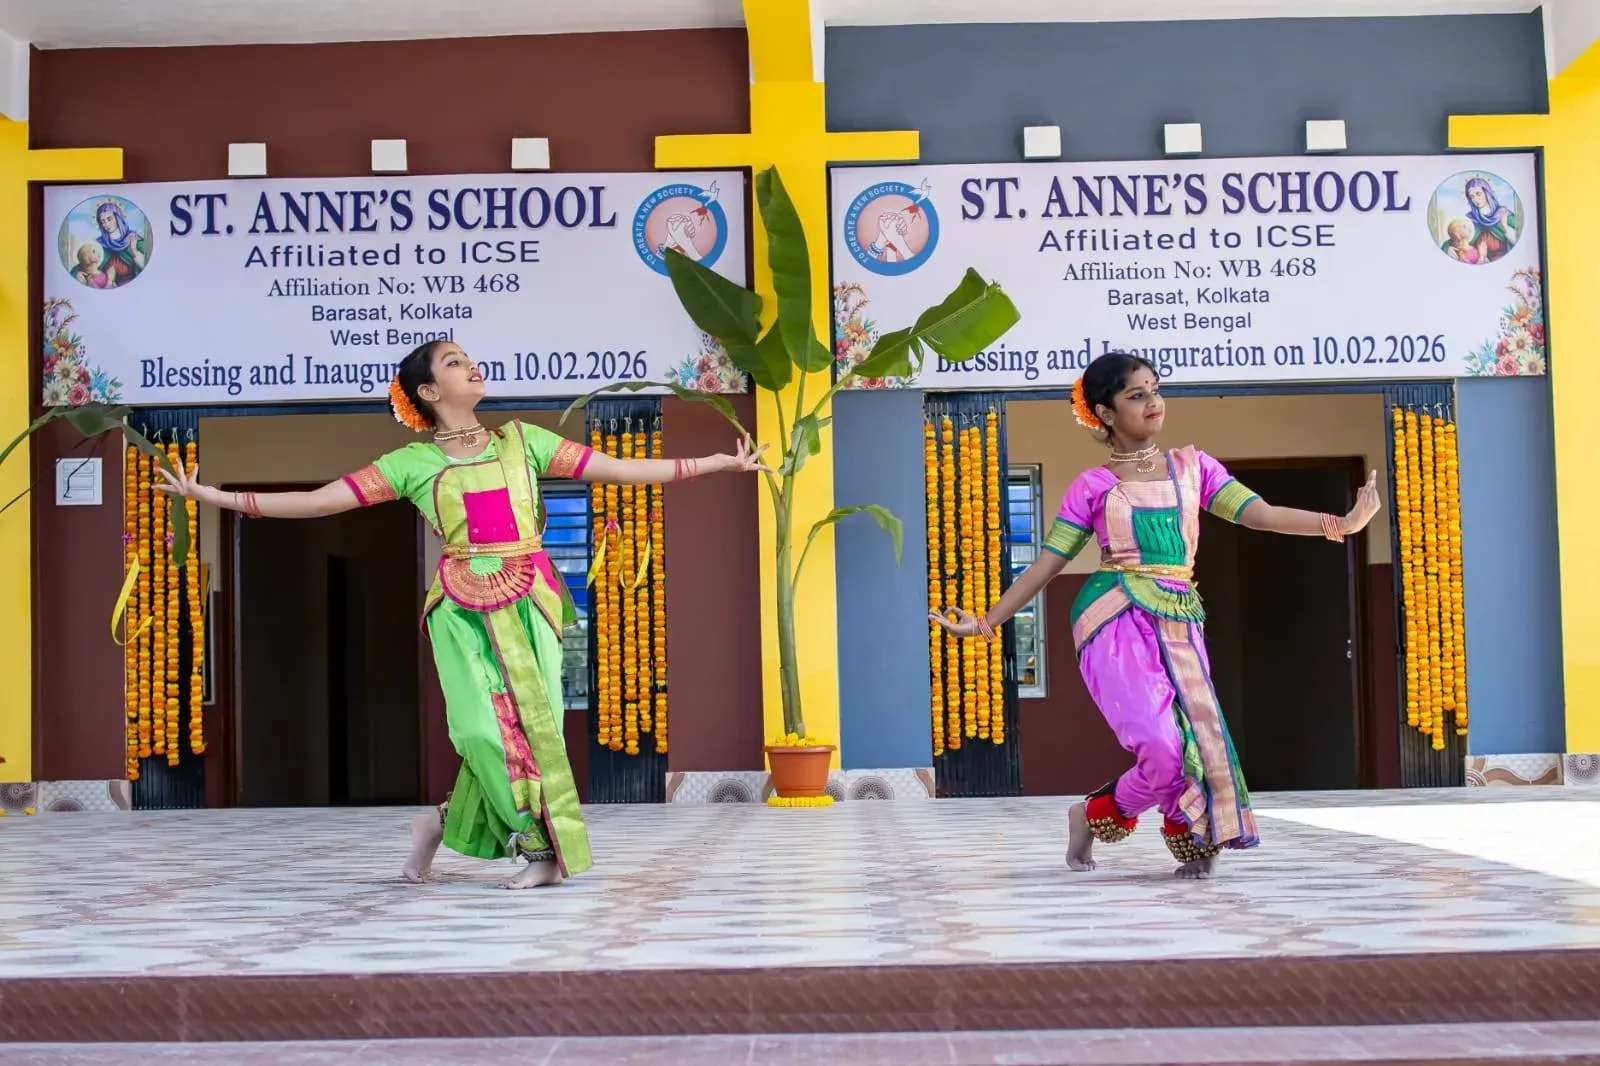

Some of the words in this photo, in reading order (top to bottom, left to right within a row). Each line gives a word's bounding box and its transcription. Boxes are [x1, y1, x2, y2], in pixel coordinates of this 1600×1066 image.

[657, 187, 694, 200] SOCIETY
[868, 185, 905, 197] SOCIETY
[961, 177, 1027, 220] ST.
[1041, 173, 1208, 218] ANNE’S
[1221, 170, 1411, 215] SCHOOL
[169, 192, 234, 236] ST.
[247, 188, 414, 234] ANNE’S
[428, 185, 617, 231] SCHOOL
[642, 197, 657, 213] NEW
[853, 195, 868, 212] NEW
[635, 221, 648, 254] CREATE
[847, 220, 860, 252] CREATE
[1038, 228, 1196, 252] Affiliated
[1209, 228, 1242, 249] to
[1257, 225, 1336, 248] ICSE
[244, 243, 401, 268] Affiliated
[414, 244, 446, 265] to
[461, 241, 540, 264] ICSE
[646, 254, 657, 265] TO
[858, 253, 869, 263] TO
[1062, 262, 1166, 281] Affiliation
[1174, 260, 1211, 279] No:
[1219, 260, 1262, 278] WB
[1270, 257, 1317, 277] 468
[267, 277, 370, 297] Affiliation
[378, 276, 415, 295] No:
[423, 276, 465, 294] WB
[473, 273, 520, 293] 468
[1108, 289, 1189, 307] Barasat,
[1197, 287, 1270, 304] Kolkata
[311, 305, 392, 323] Barasat,
[400, 303, 473, 320] Kolkata
[1126, 314, 1177, 331] West
[1184, 312, 1251, 333] Bengal
[330, 329, 380, 346] West
[1047, 337, 1091, 369] and
[1274, 345, 1305, 366] on
[1312, 334, 1446, 365] 10.02.2026
[140, 356, 243, 395] Blessing
[250, 353, 297, 386] and
[514, 350, 647, 381] 10.02.2026
